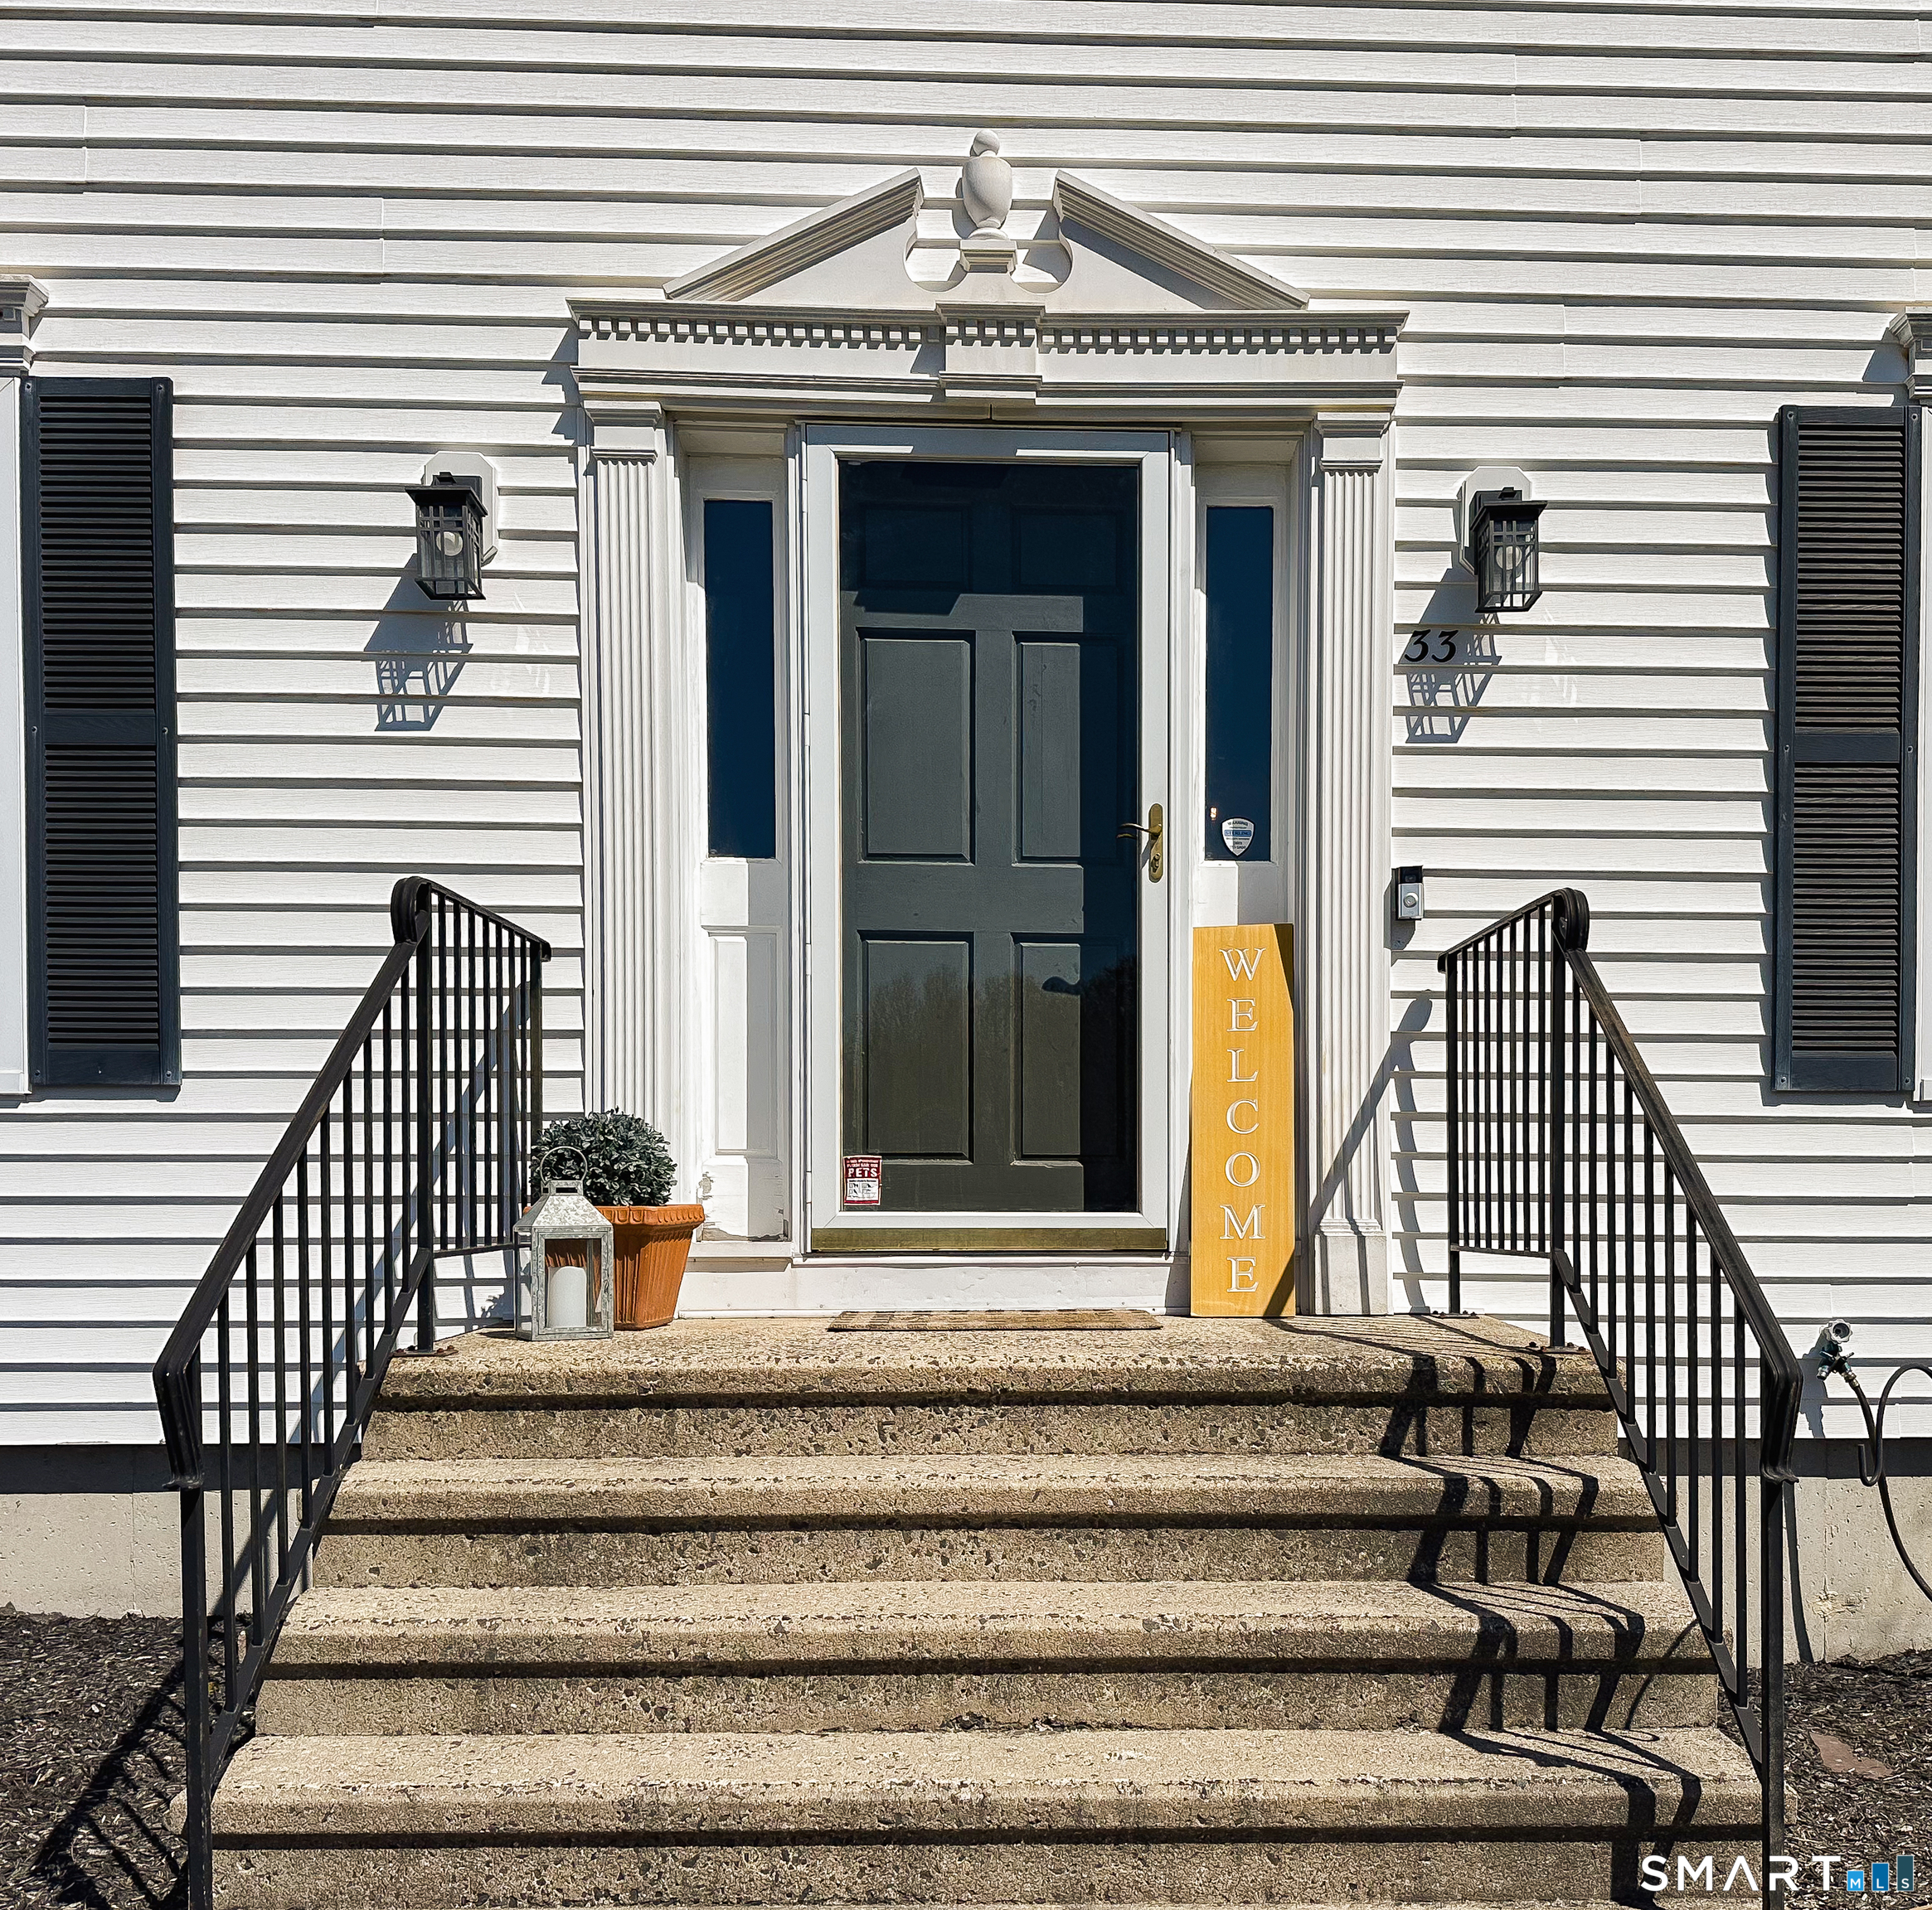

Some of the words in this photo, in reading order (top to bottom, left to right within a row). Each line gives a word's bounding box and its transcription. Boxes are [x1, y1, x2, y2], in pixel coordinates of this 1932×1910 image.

[1405, 629, 1459, 662] 33
[1219, 948, 1267, 1293] WELCOME
[847, 1167, 878, 1177] PETS
